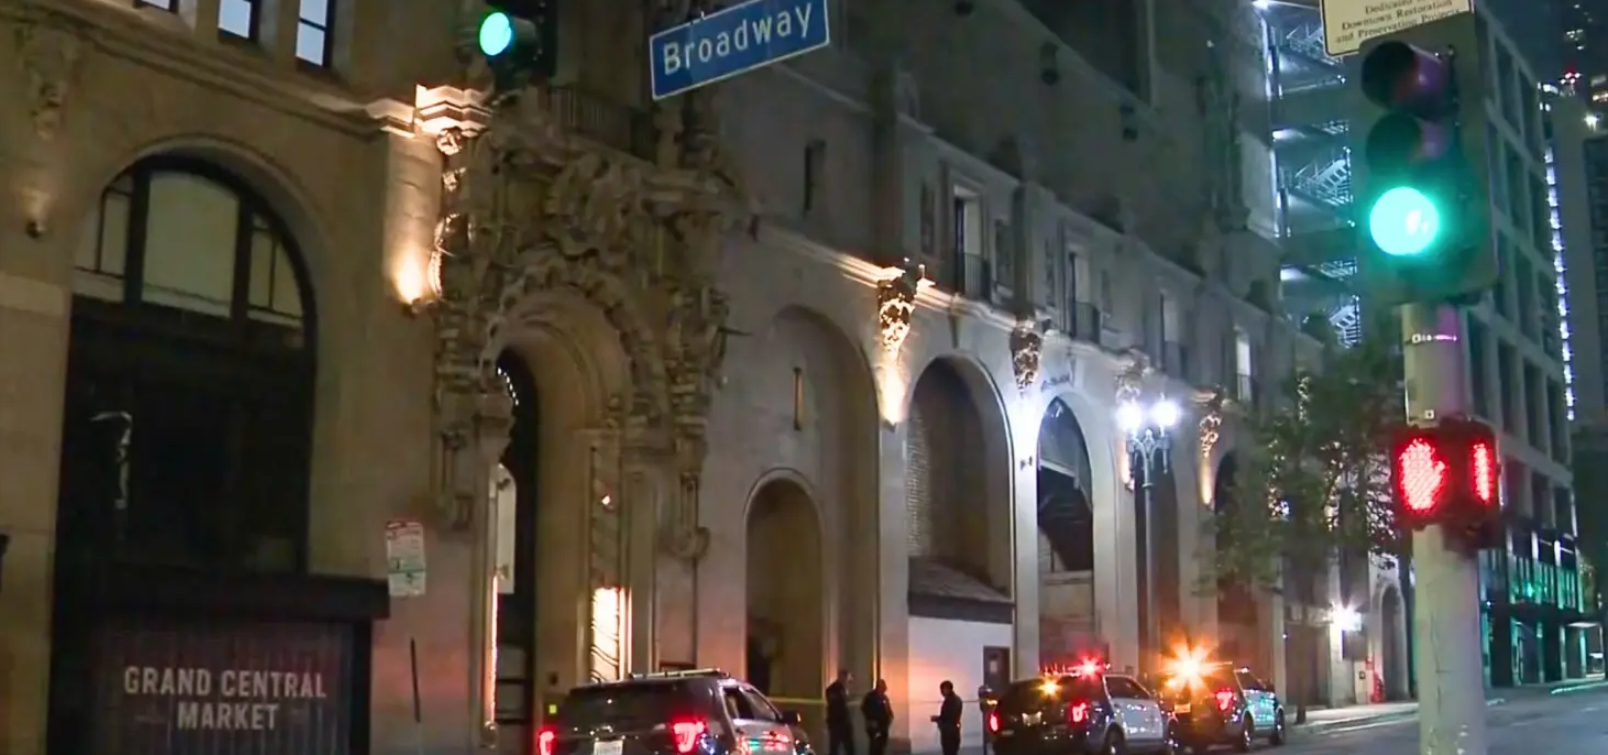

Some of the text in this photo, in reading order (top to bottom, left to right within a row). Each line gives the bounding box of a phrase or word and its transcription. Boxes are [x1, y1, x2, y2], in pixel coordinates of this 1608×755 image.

[1342, 0, 1452, 31] Downtown Restoration
[663, 2, 812, 76] Broadway
[124, 666, 327, 698] GRAND CENTRAL
[177, 702, 279, 731] MARKET
